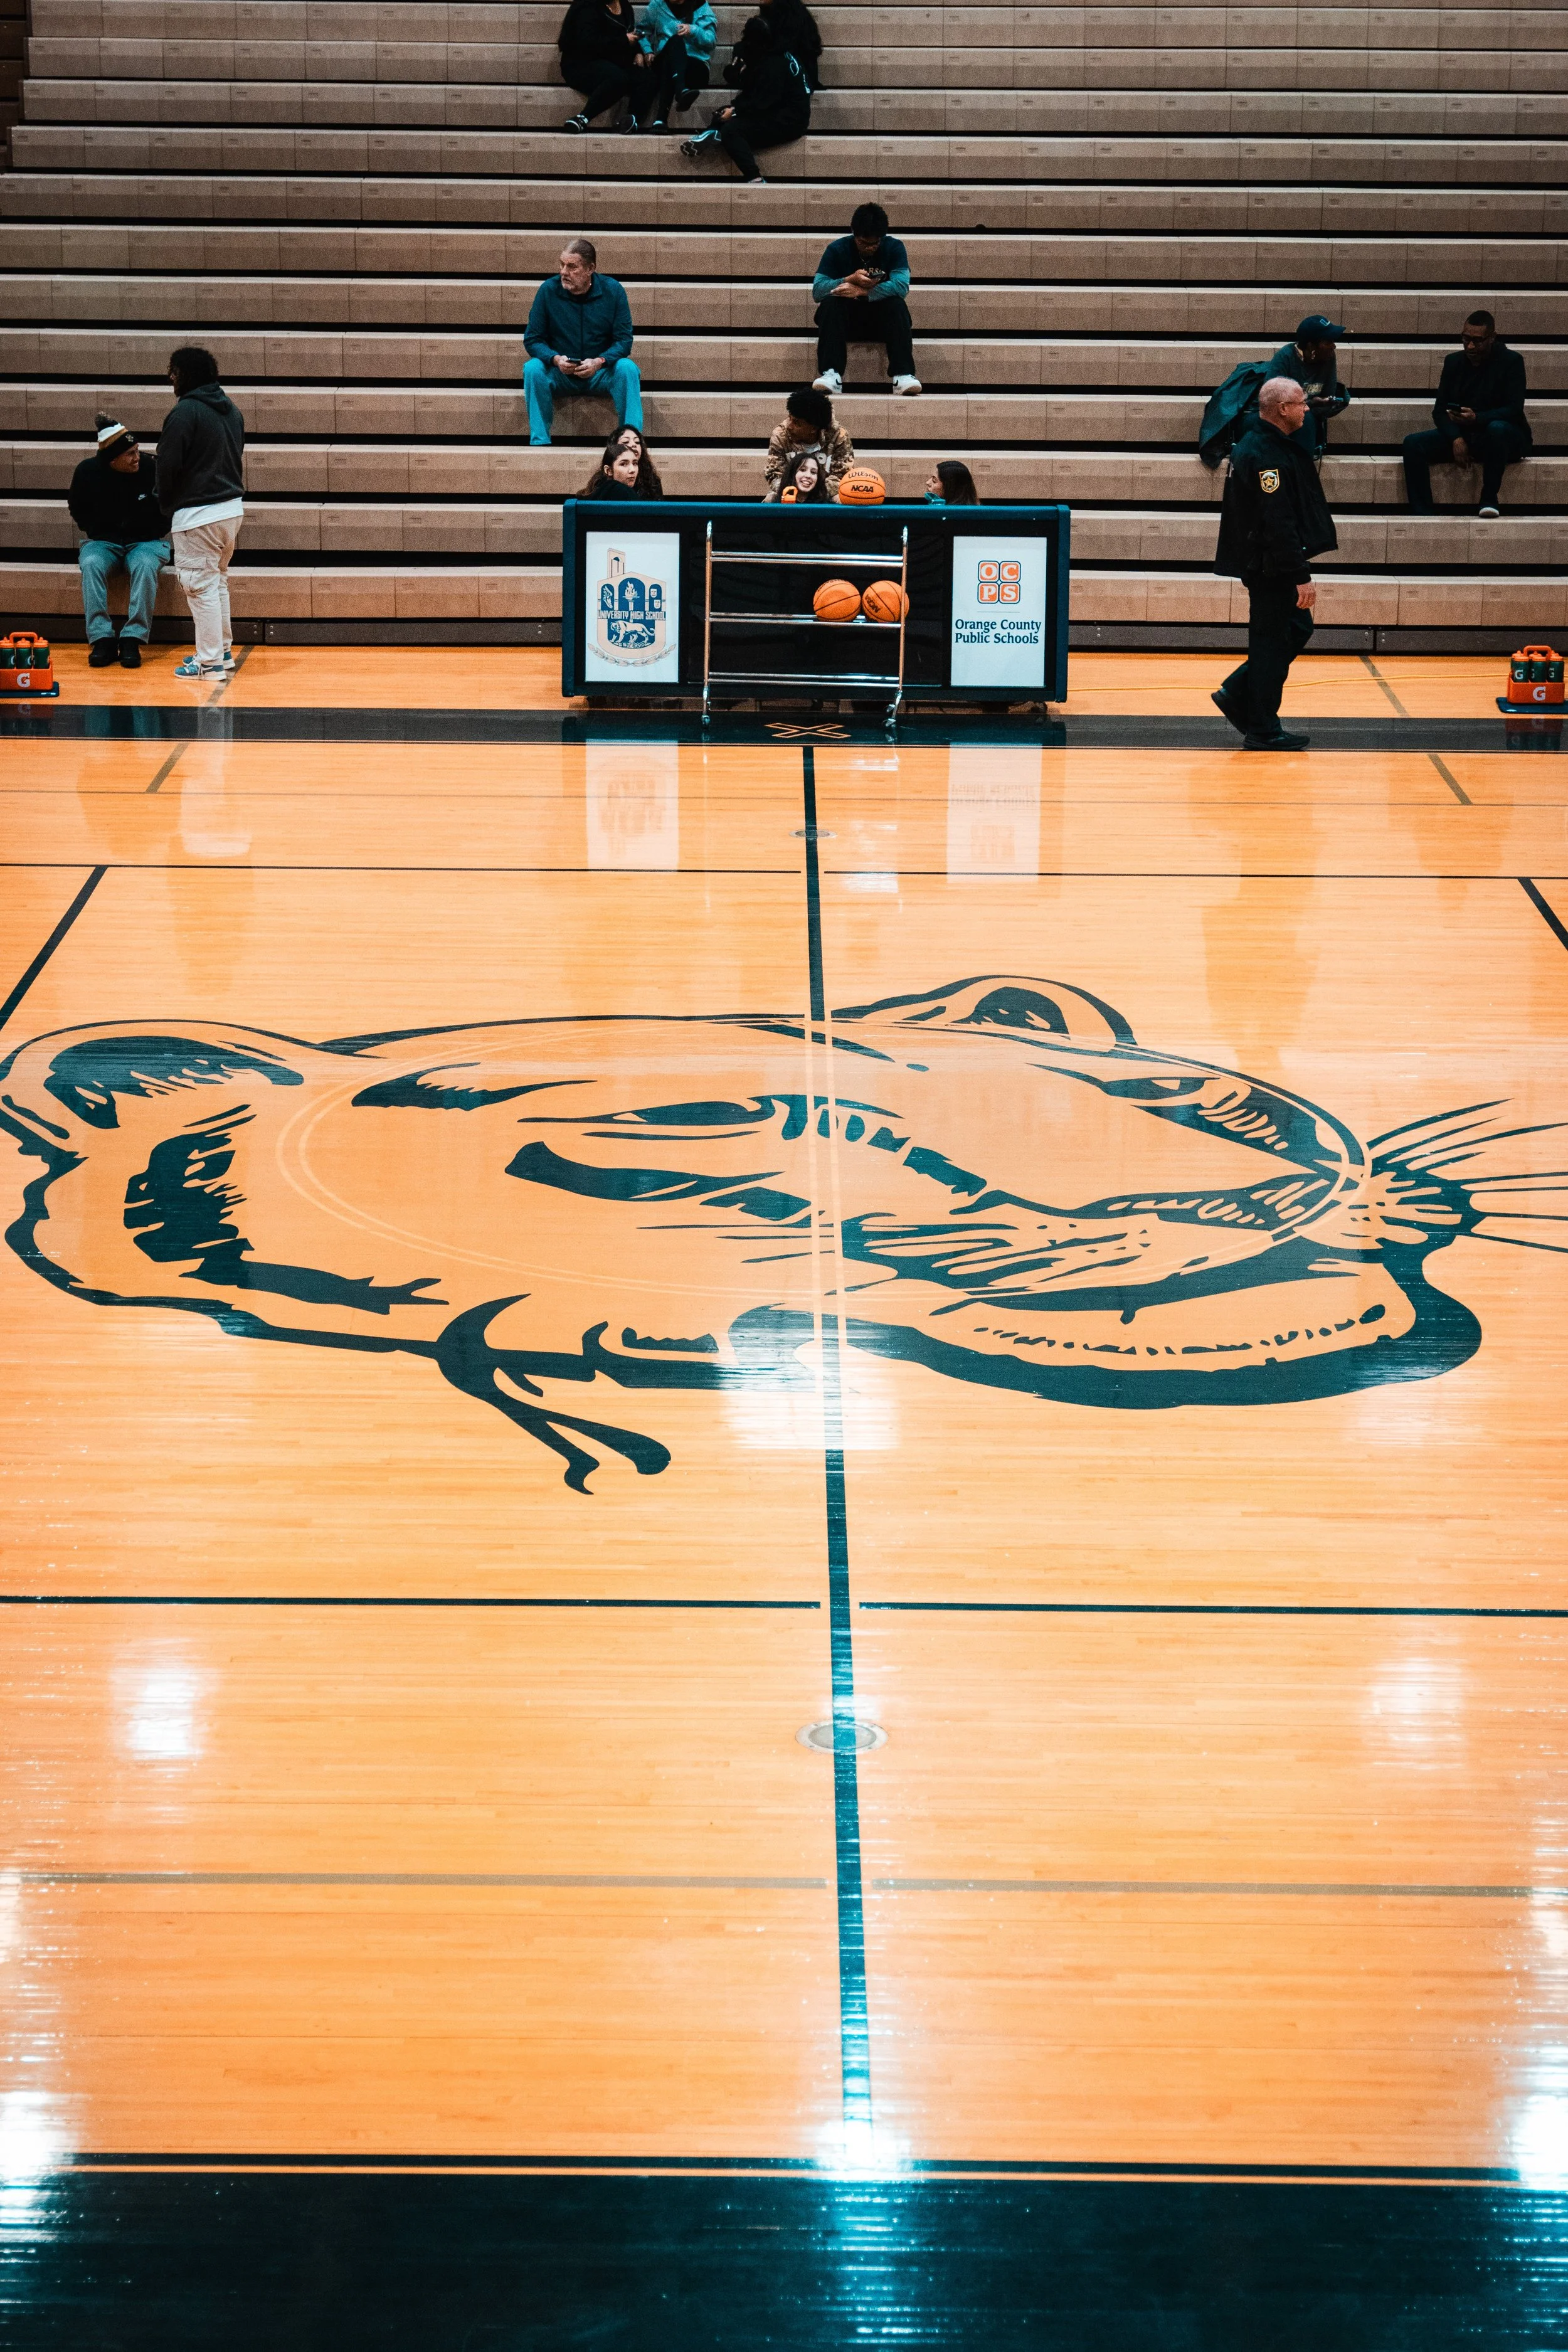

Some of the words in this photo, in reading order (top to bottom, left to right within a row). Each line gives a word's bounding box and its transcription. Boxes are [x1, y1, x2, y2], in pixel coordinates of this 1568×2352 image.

[848, 471, 878, 481] Wilson
[851, 485, 874, 493] NCAA
[597, 610, 629, 619] UNIVERSITY
[631, 611, 644, 620] HIGH
[645, 611, 666, 620] SCHOOL
[955, 619, 997, 633] Orange
[1000, 620, 1042, 633] County
[955, 632, 990, 643] Public
[993, 632, 1039, 644] Schools
[1515, 669, 1523, 679] G
[17, 672, 31, 688] G
[1532, 686, 1546, 701] G
